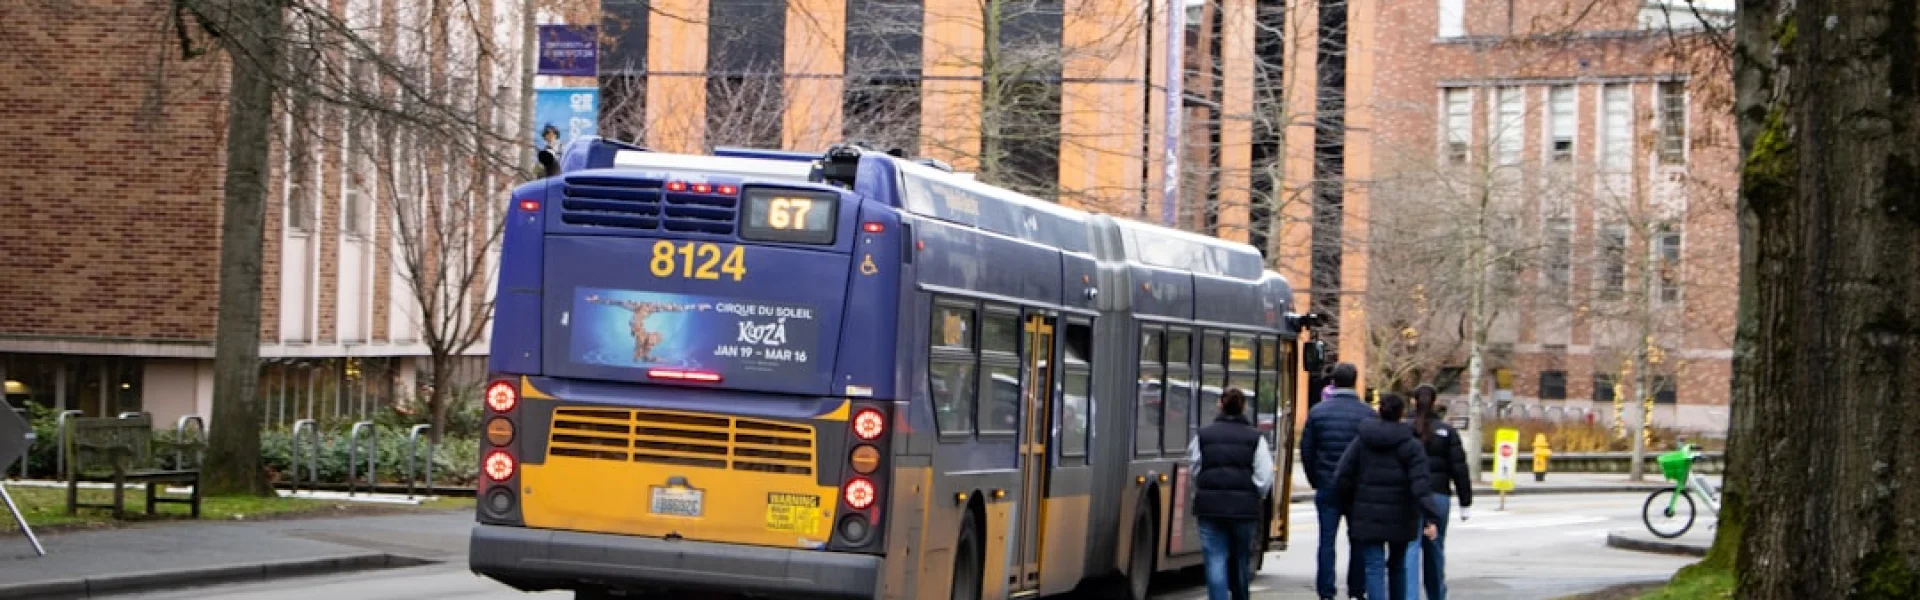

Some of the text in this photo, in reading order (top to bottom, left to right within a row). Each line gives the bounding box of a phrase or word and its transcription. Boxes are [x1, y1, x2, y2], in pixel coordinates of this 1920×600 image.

[768, 197, 812, 229] 67
[650, 240, 747, 281] 8124
[716, 303, 812, 319] CIRQUE DU SOLEIL
[714, 345, 739, 357] JAN
[740, 347, 753, 357] 19
[765, 348, 792, 360] MAR
[794, 351, 808, 362] 16
[770, 494, 818, 507] WARNING
